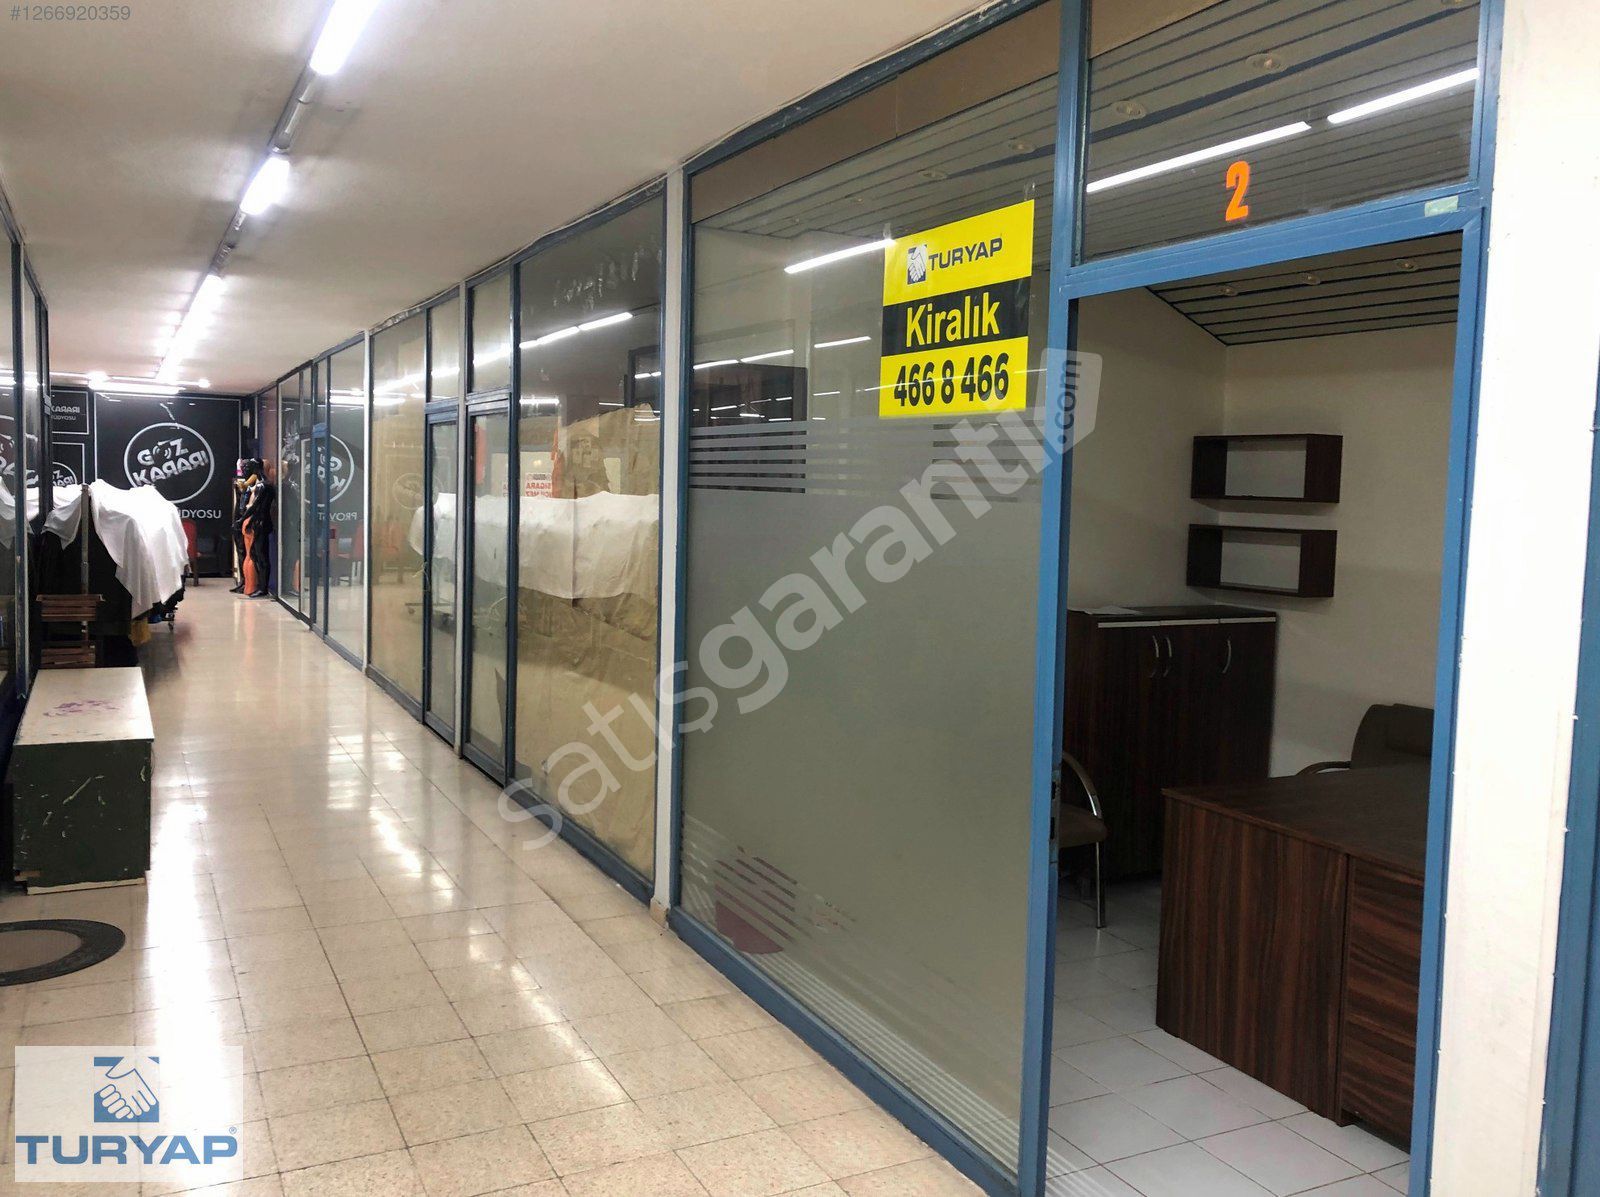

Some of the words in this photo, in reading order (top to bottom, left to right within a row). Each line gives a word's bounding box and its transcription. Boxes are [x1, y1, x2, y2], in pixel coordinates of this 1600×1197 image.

[1225, 160, 1250, 222] 2
[928, 237, 1003, 271] TURYAP
[906, 291, 1001, 348] Kiralık
[893, 361, 935, 407] 466
[940, 359, 955, 405] 8
[960, 352, 1010, 402] 466
